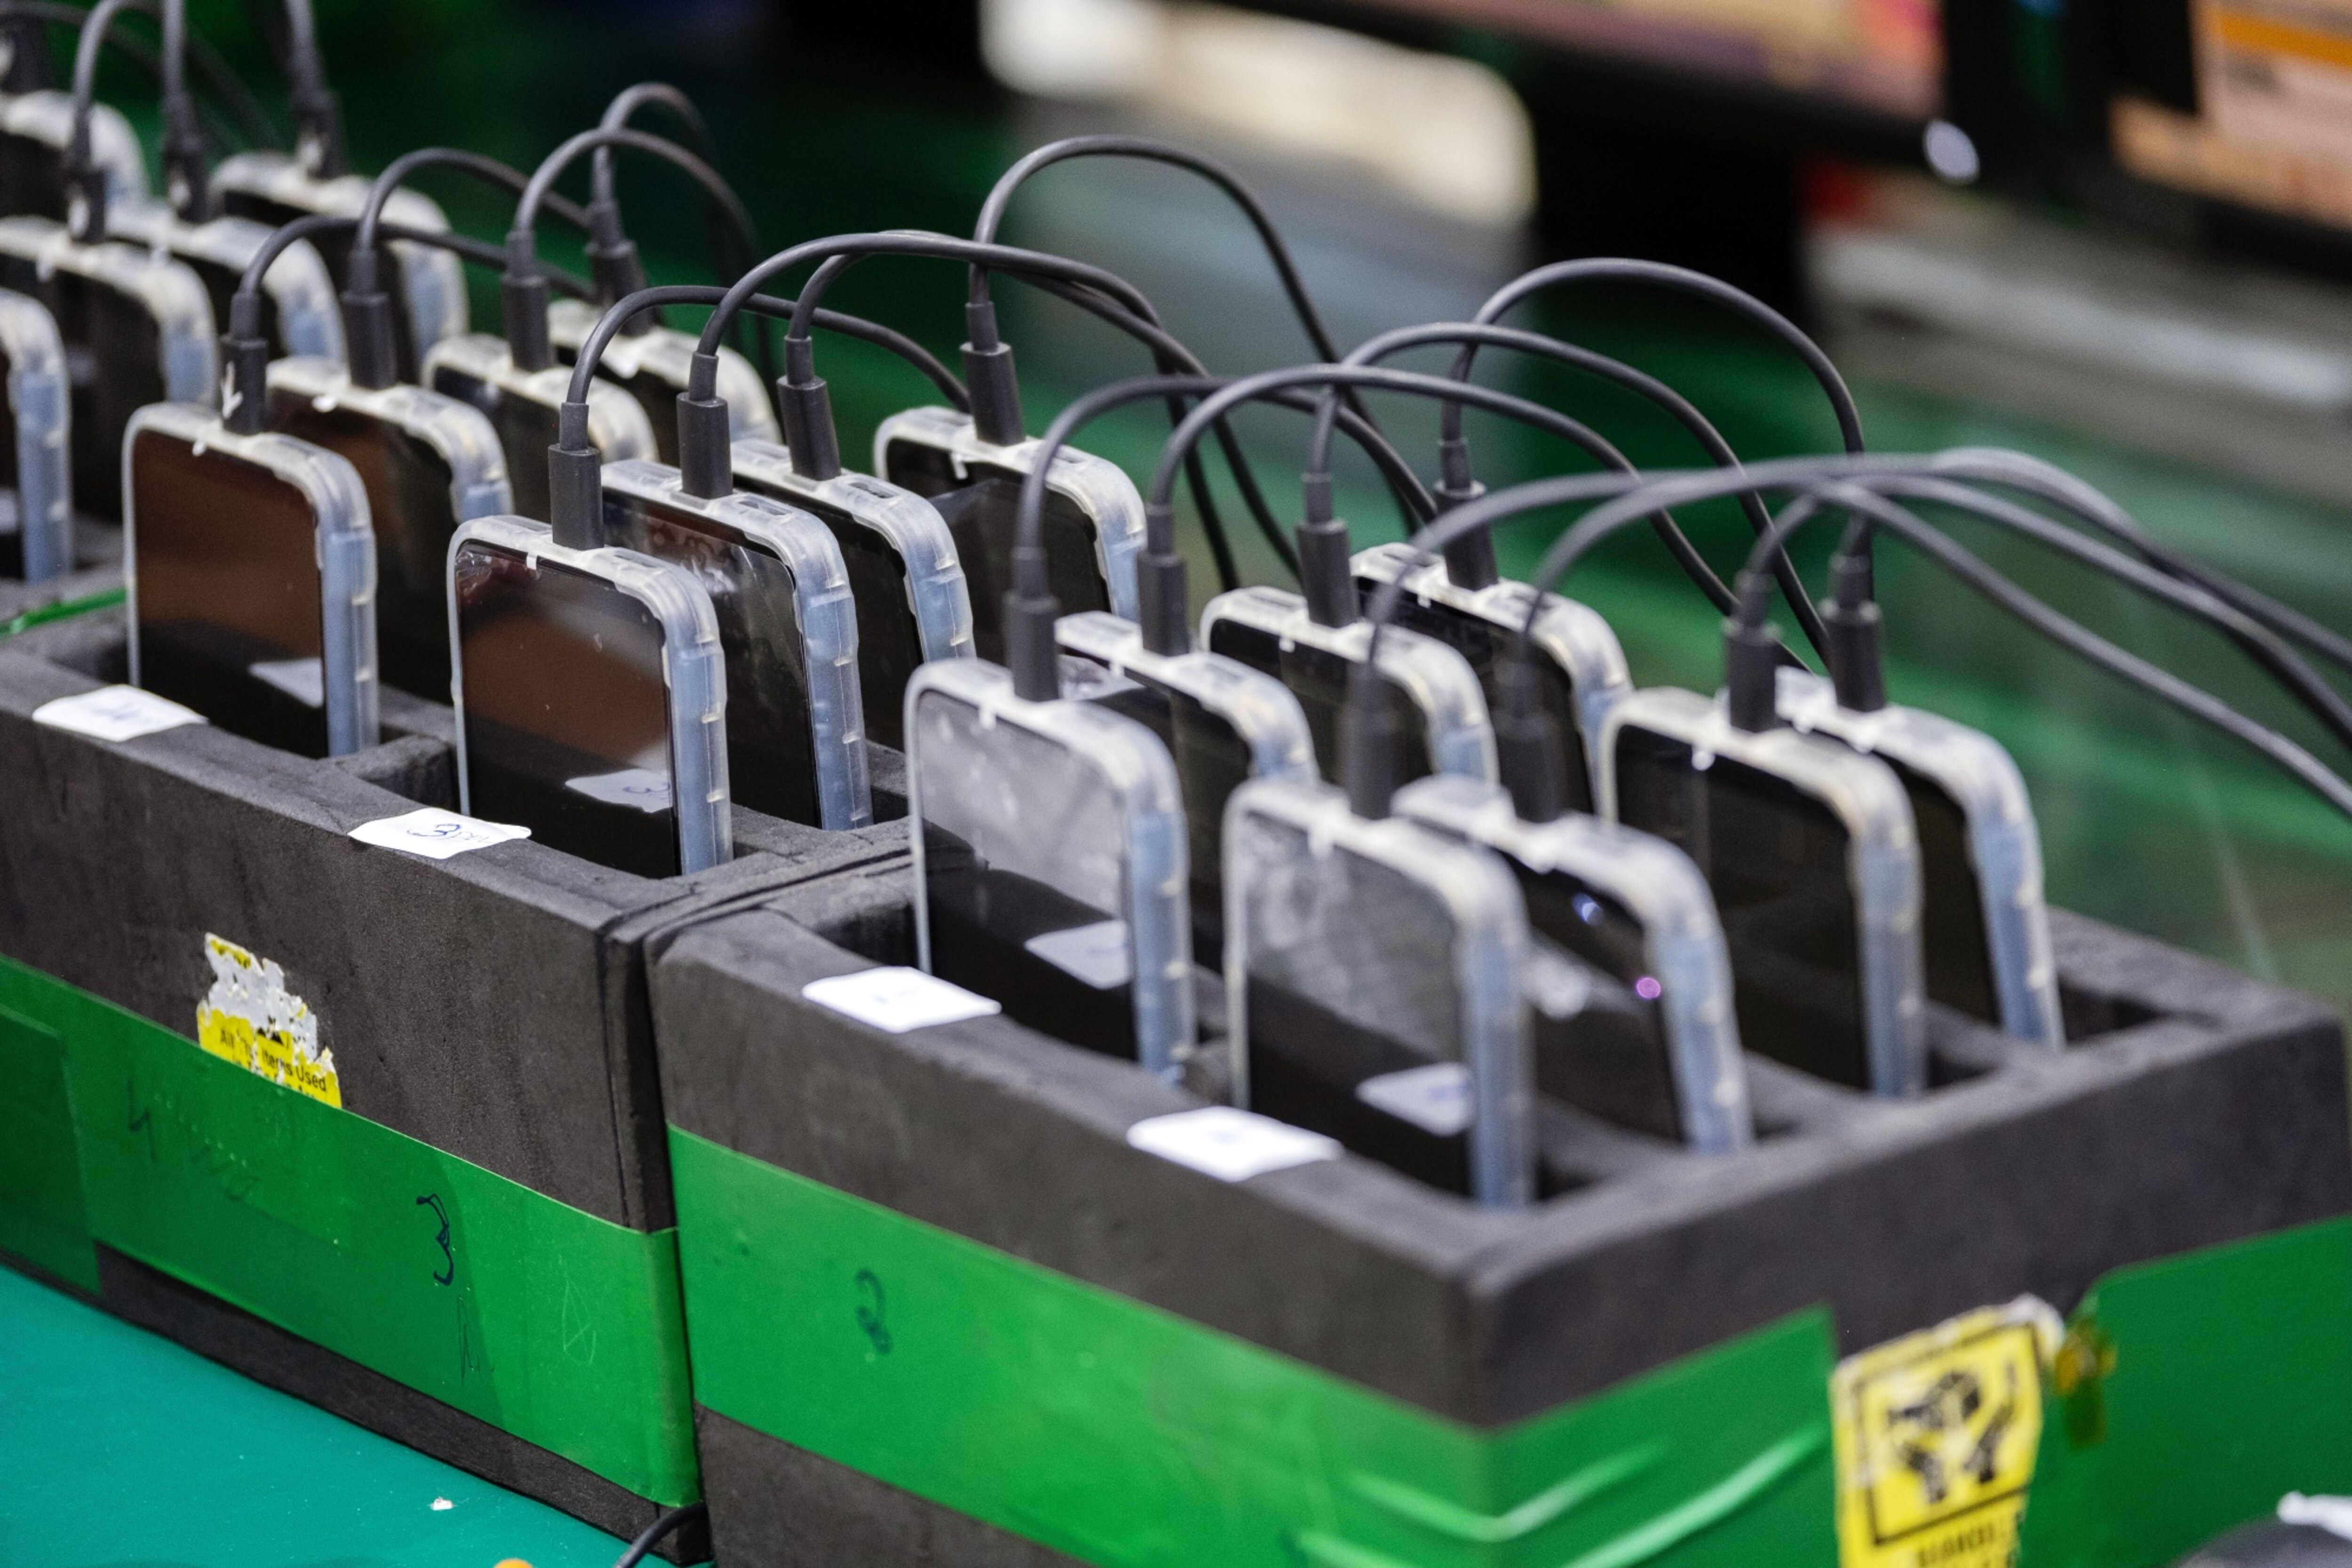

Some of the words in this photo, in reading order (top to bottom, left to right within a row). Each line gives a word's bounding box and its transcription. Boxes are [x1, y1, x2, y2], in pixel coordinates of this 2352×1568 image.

[221, 1028, 234, 1049] All
[296, 1066, 326, 1092] Used
[416, 1193, 454, 1286] 3
[854, 1268, 892, 1356] 2
